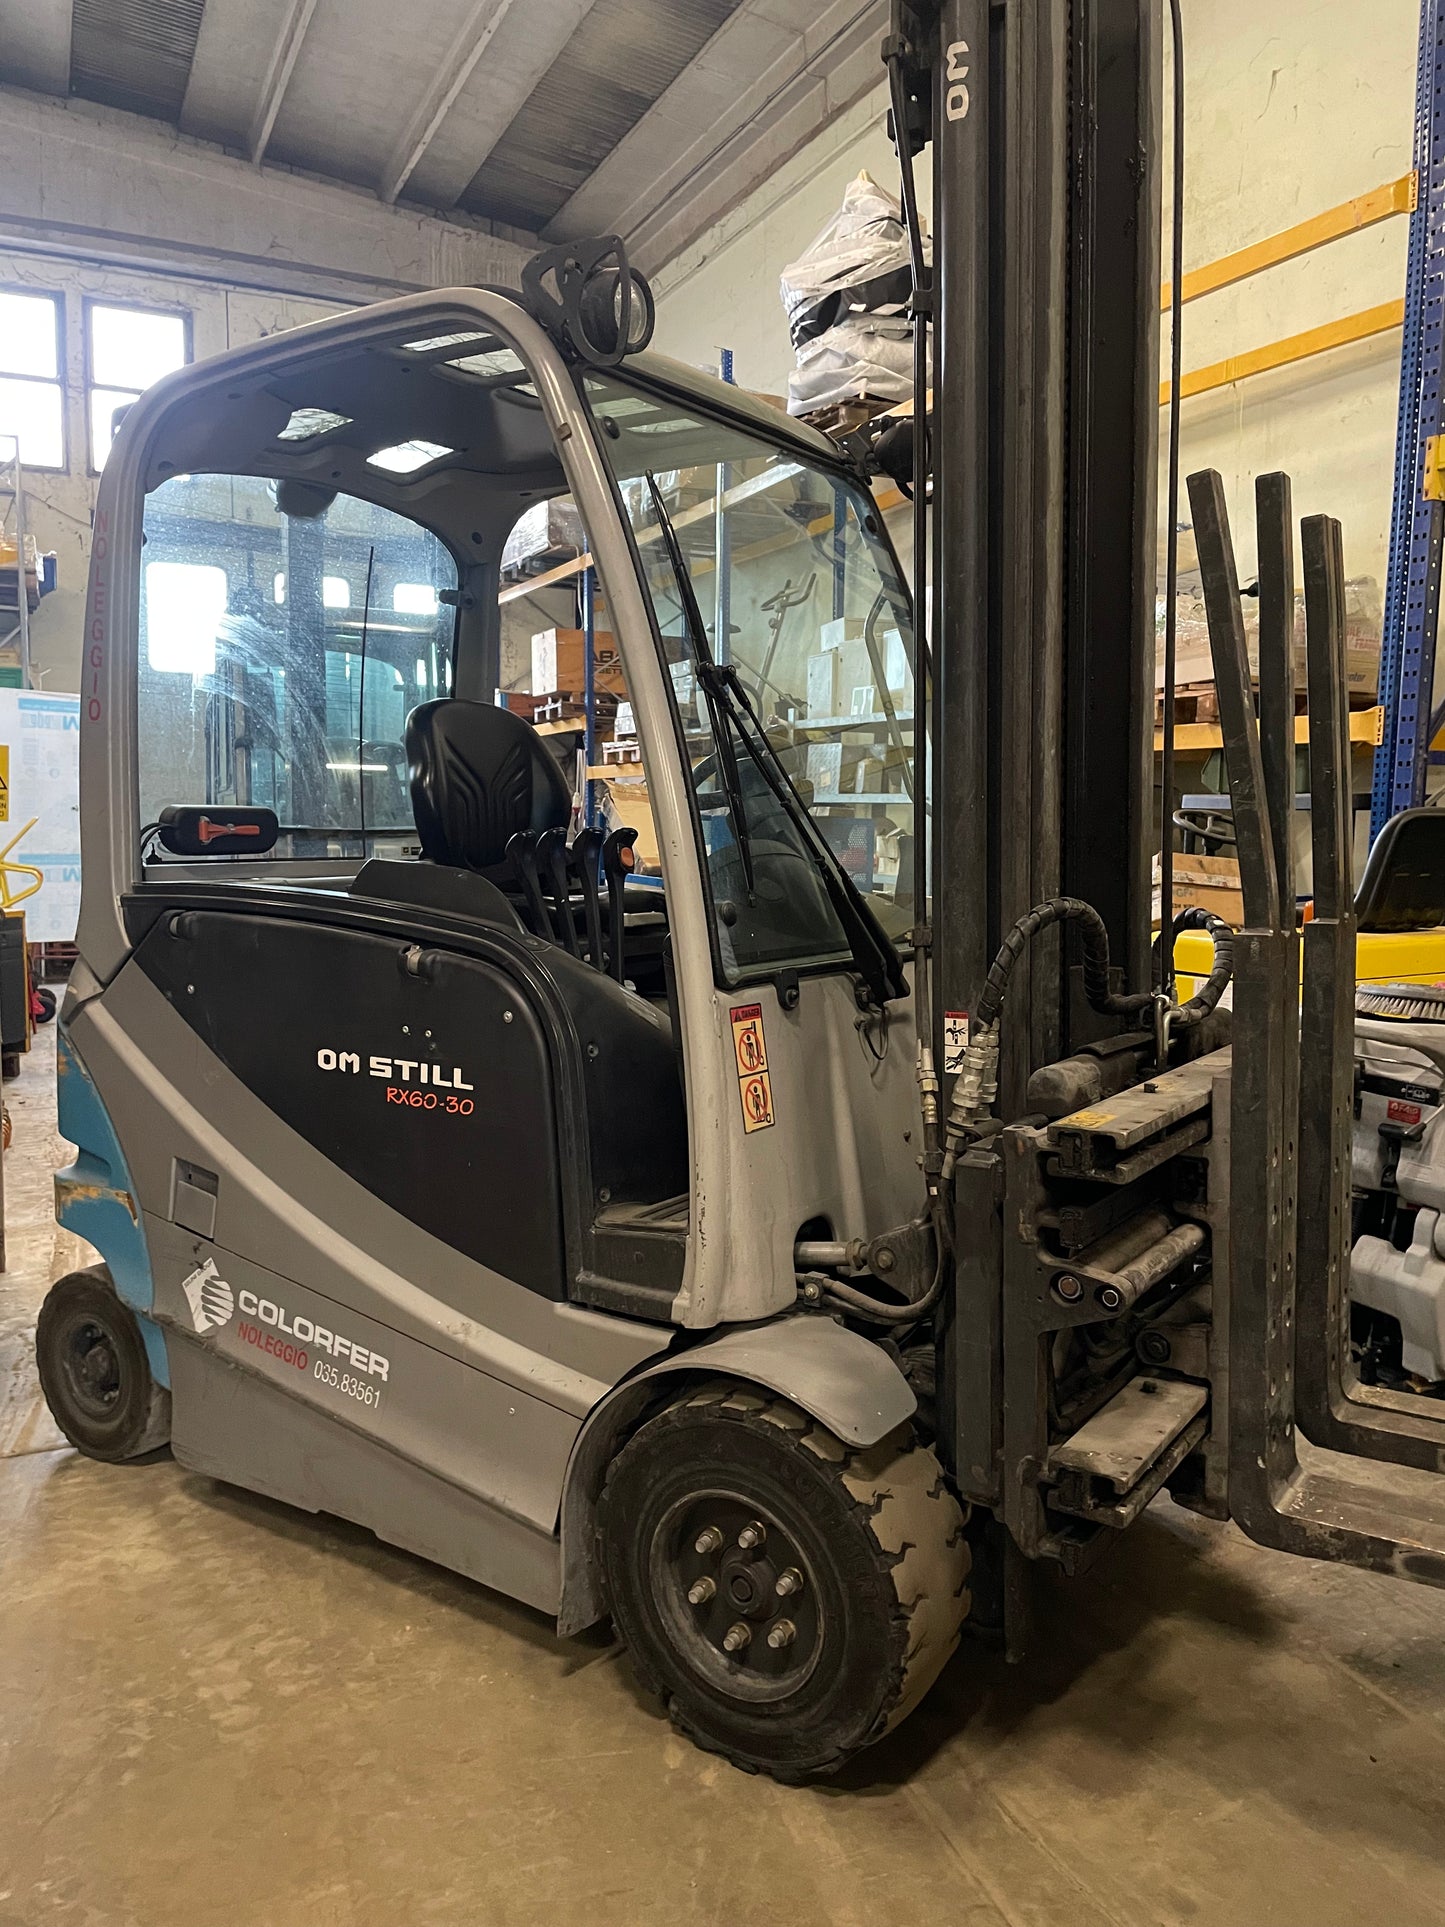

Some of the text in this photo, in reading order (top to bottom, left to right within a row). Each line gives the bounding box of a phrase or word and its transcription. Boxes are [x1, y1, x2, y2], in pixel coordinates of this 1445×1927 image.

[946, 41, 969, 121] OM
[88, 510, 109, 721] NOLEGGIO
[317, 1048, 474, 1091] OM STILL
[386, 1086, 474, 1115] RX60-30
[237, 1321, 381, 1409] NOLEGGIO 035.83561
[238, 1289, 390, 1382] COLORFER
